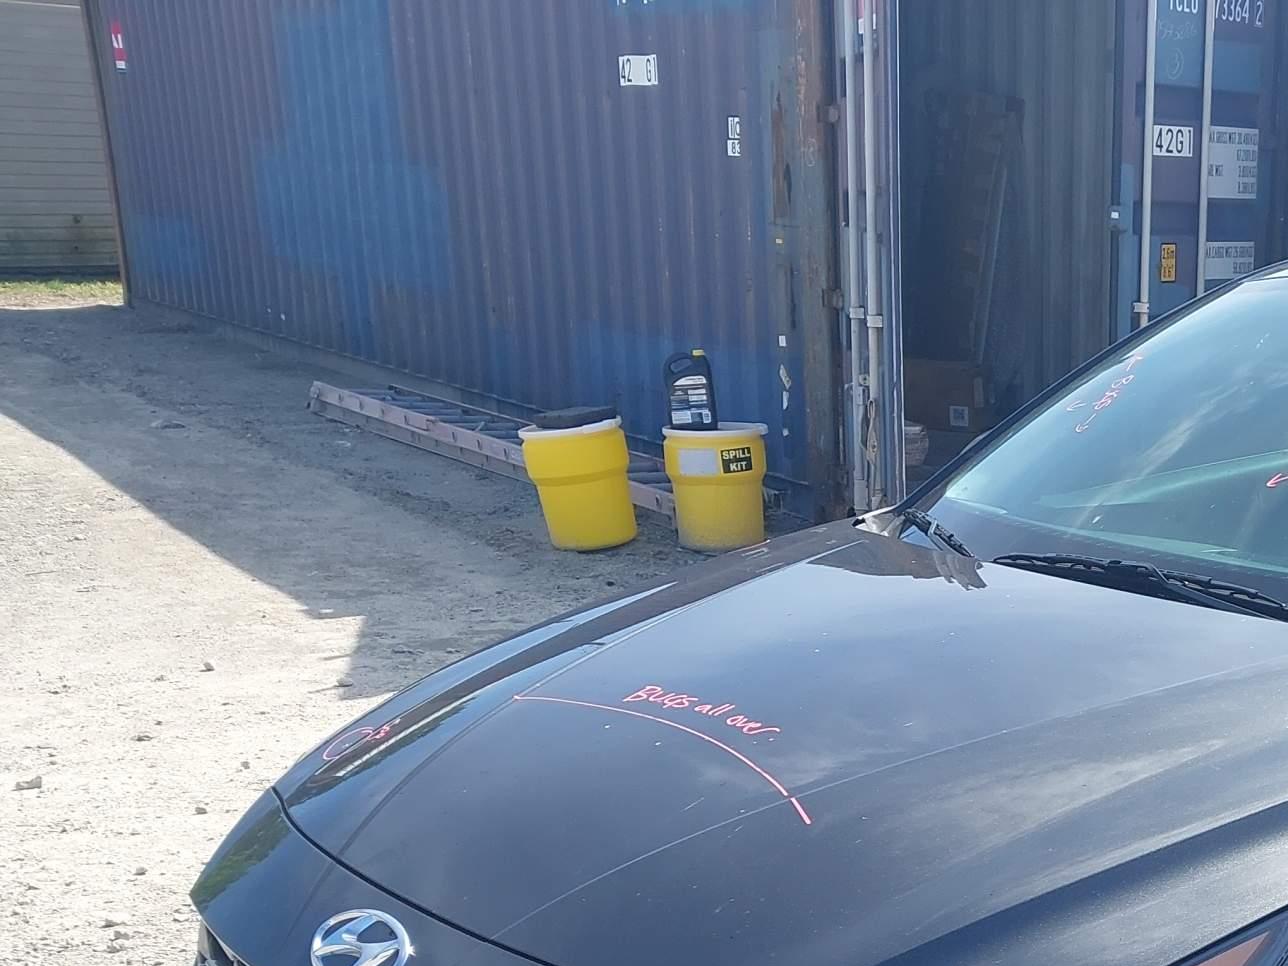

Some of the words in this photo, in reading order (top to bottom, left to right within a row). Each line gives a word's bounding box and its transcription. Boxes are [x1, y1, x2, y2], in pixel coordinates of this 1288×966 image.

[1255, 1, 1262, 25] 2
[620, 57, 633, 84] 42
[1155, 128, 1192, 155] 42G1
[721, 447, 751, 460] SPILL
[729, 461, 748, 472] KIT
